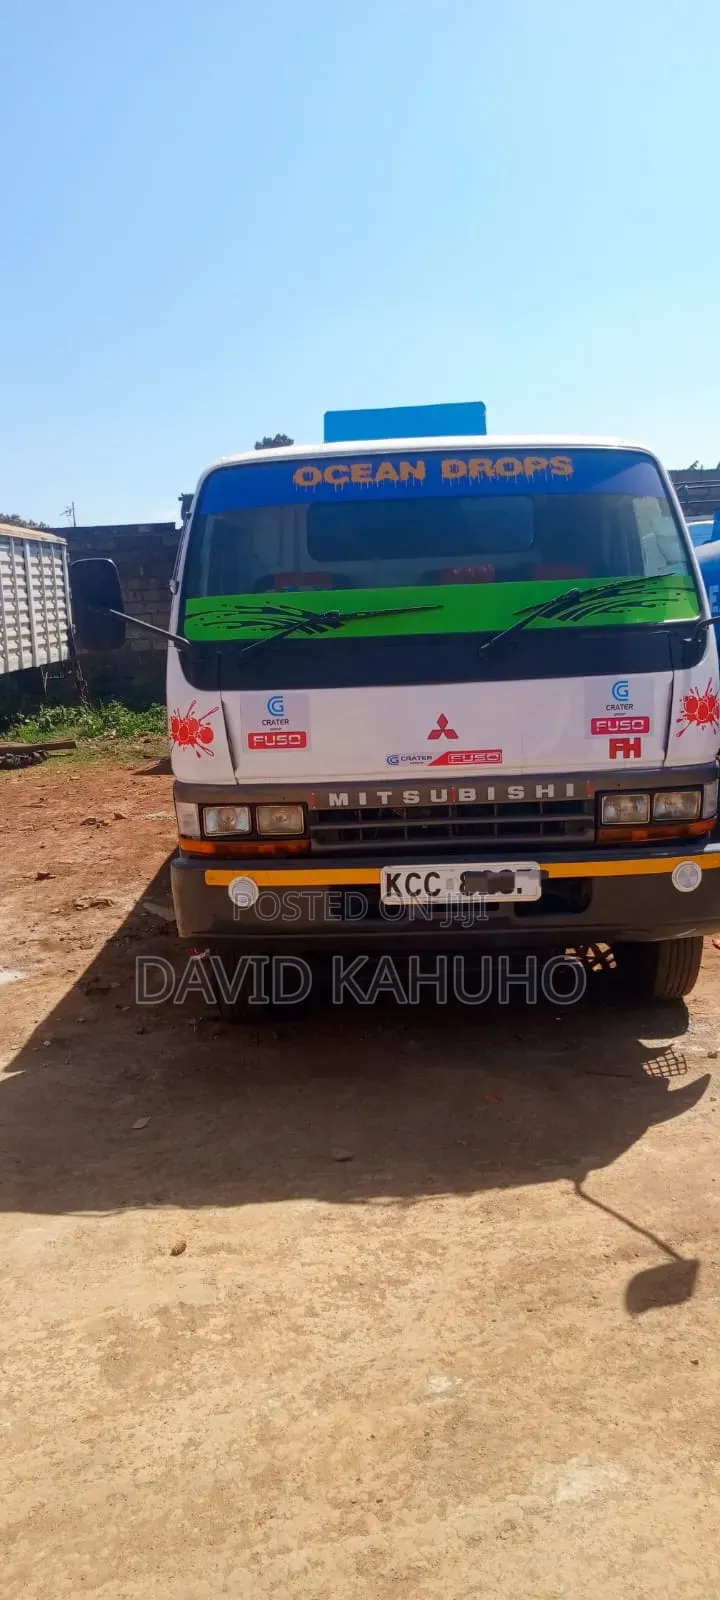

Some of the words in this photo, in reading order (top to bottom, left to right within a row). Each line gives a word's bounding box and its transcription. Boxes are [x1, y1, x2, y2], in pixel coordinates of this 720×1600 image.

[293, 460, 425, 490] OCEAN
[441, 456, 573, 485] DROPS
[605, 703, 634, 711] CRATER
[262, 718, 290, 726] CRATER
[596, 719, 644, 732] FUSO
[253, 734, 301, 746] FUSO
[609, 737, 642, 759] FH
[449, 753, 500, 763] FUSO
[328, 783, 575, 807] MITSUBISHI
[386, 872, 441, 897] KCC
